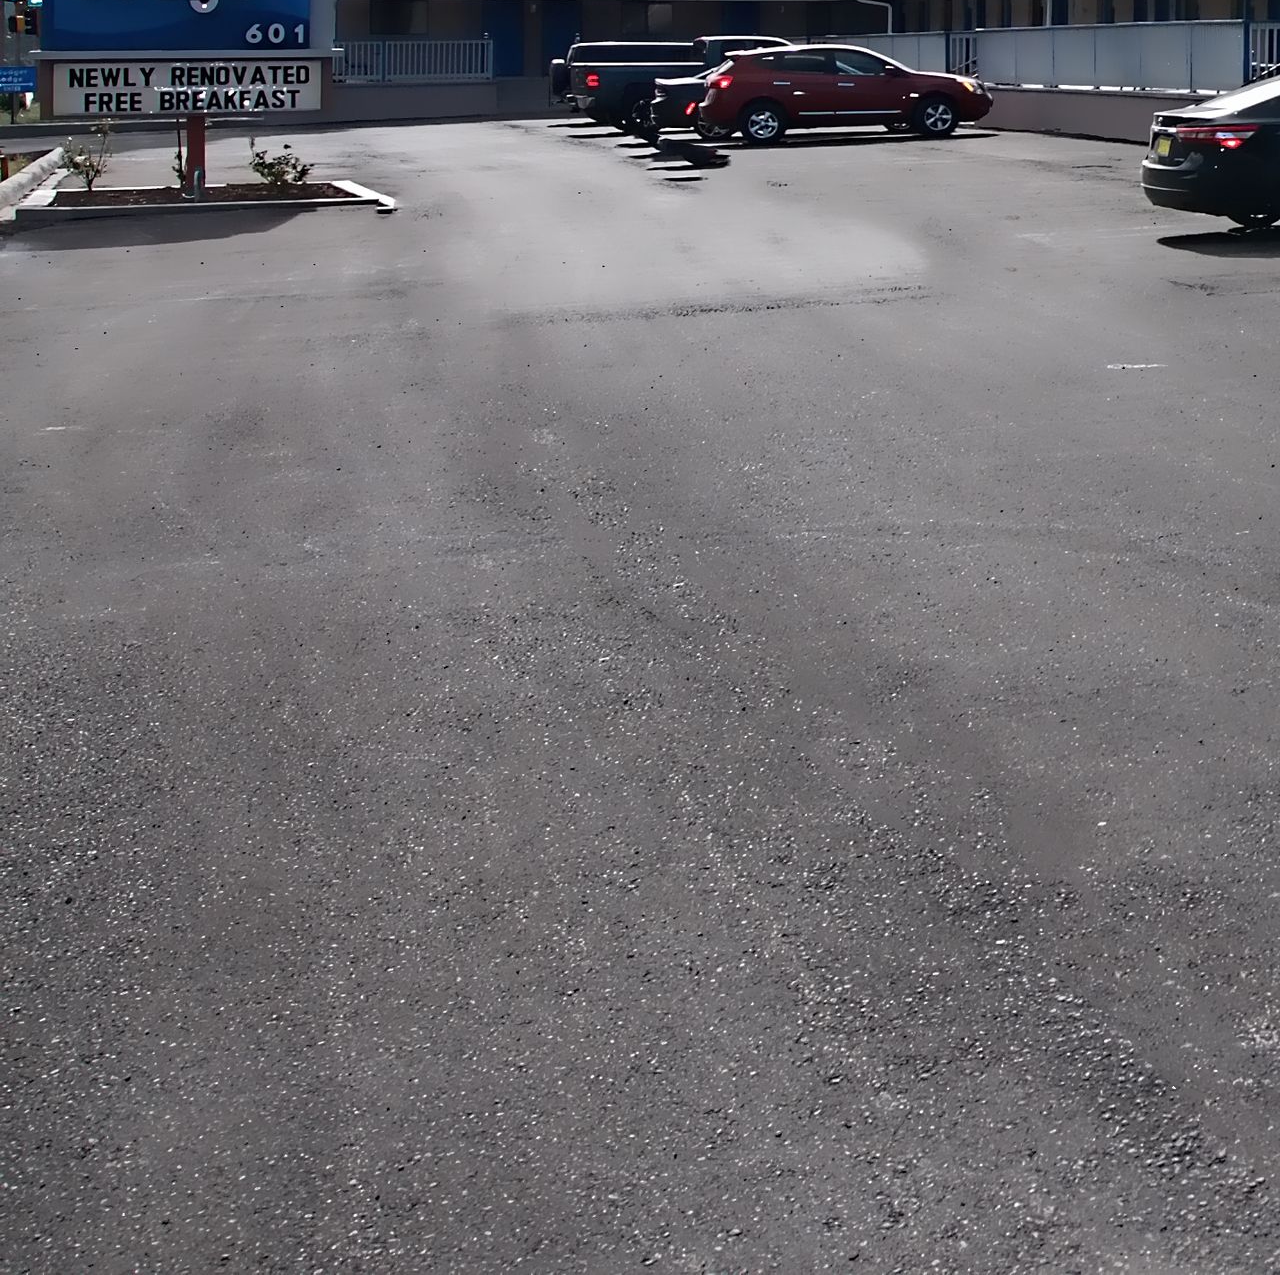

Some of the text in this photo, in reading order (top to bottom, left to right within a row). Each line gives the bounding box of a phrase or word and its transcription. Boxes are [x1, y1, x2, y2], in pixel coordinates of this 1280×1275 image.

[245, 24, 304, 44] 601
[69, 65, 310, 87] NEWLY RENOVATED
[84, 90, 300, 112] FREE BREAKFAST
